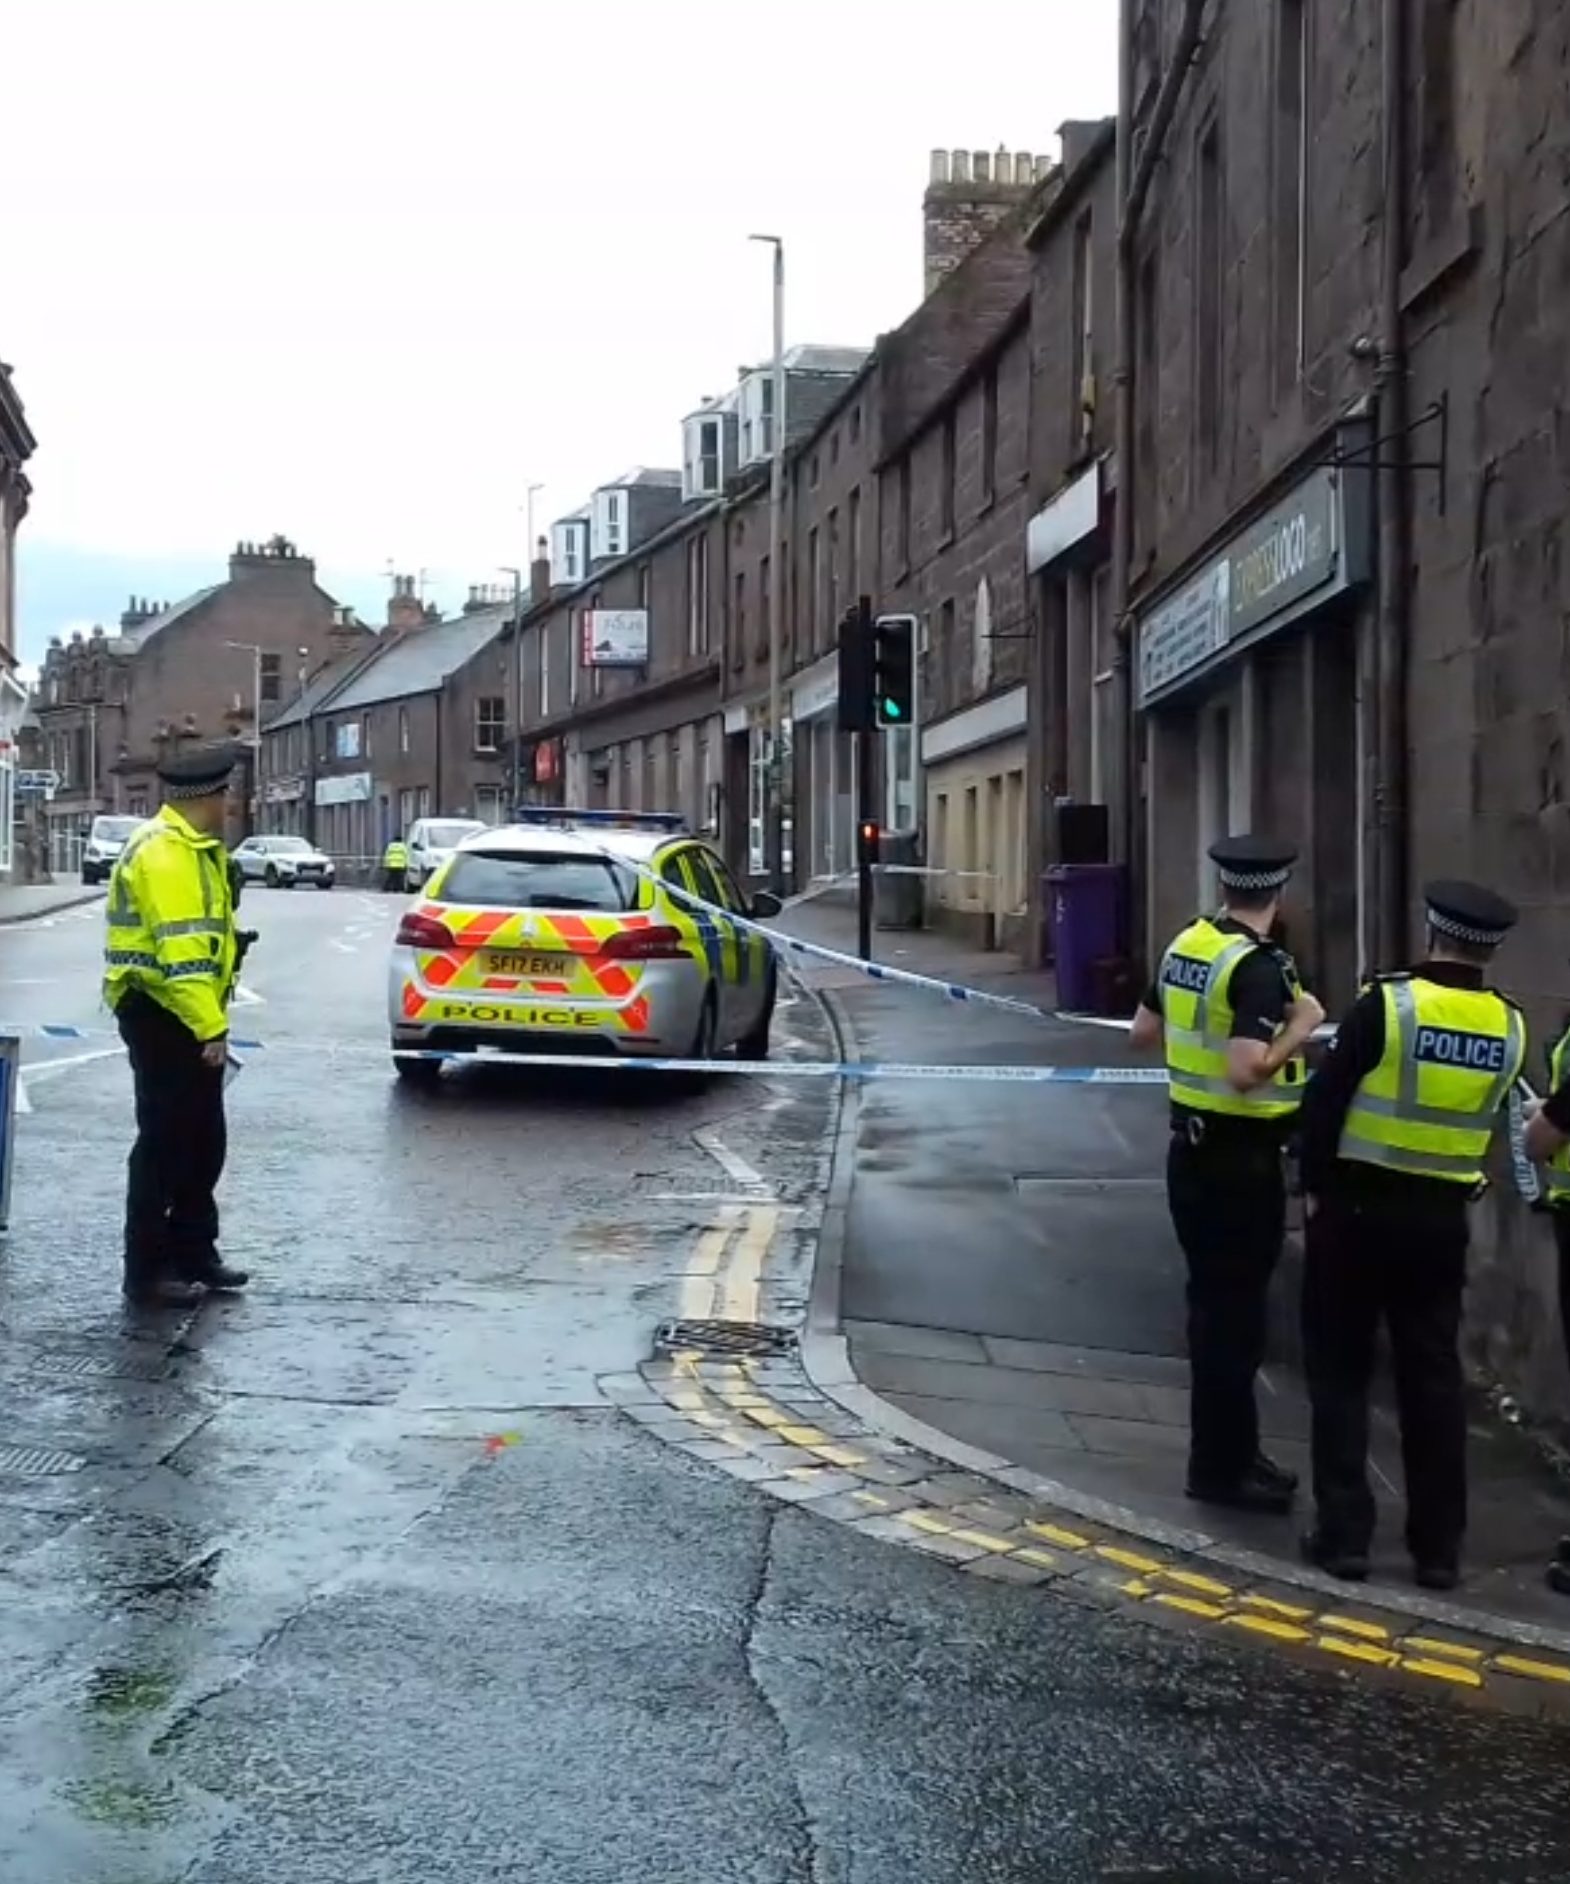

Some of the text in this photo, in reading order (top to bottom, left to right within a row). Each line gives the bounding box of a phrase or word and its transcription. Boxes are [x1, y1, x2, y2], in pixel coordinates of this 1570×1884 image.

[489, 954, 527, 969] SF17
[1162, 956, 1208, 990] POLICE
[442, 1004, 600, 1026] POLICE
[1417, 1030, 1503, 1068] POLICE
